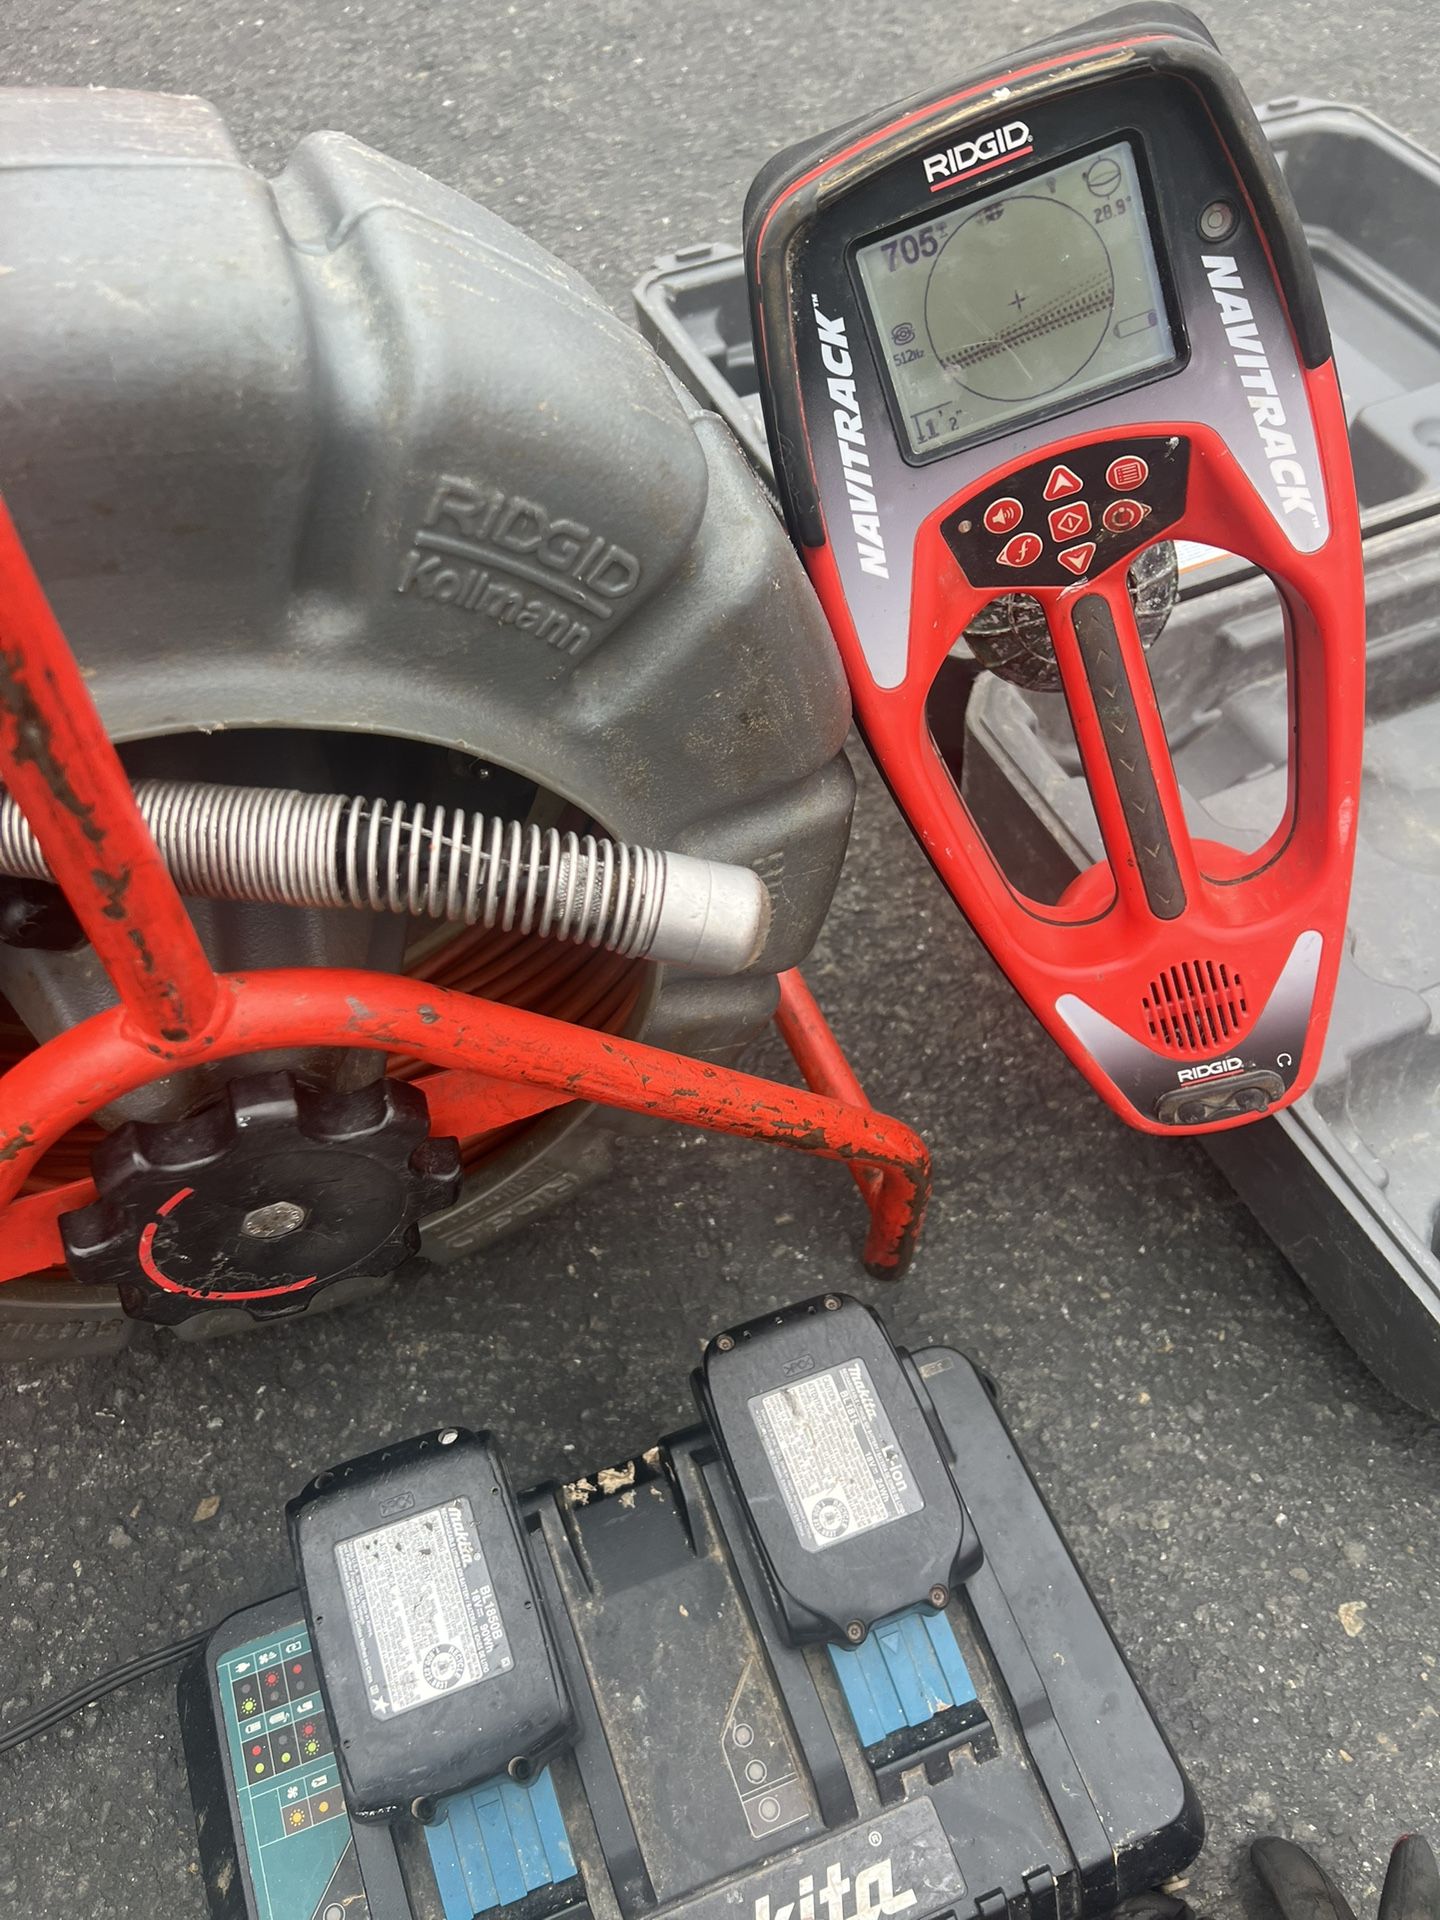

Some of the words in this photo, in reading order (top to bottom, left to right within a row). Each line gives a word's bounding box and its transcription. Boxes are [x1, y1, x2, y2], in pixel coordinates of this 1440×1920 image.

[923, 121, 1030, 183] RIDGID
[881, 225, 938, 272] 705
[893, 349, 925, 367] 512Hz
[424, 474, 640, 598] RIDGID
[397, 550, 591, 655] Kollmann
[1177, 1057, 1243, 1083] RIDGID
[847, 1362, 878, 1422] makita
[838, 1389, 860, 1426] BL1815
[874, 1476, 891, 1502] 24Wh
[447, 1506, 473, 1568] makita
[478, 1584, 503, 1640] BL1850B
[478, 1623, 495, 1653] 90Wh
